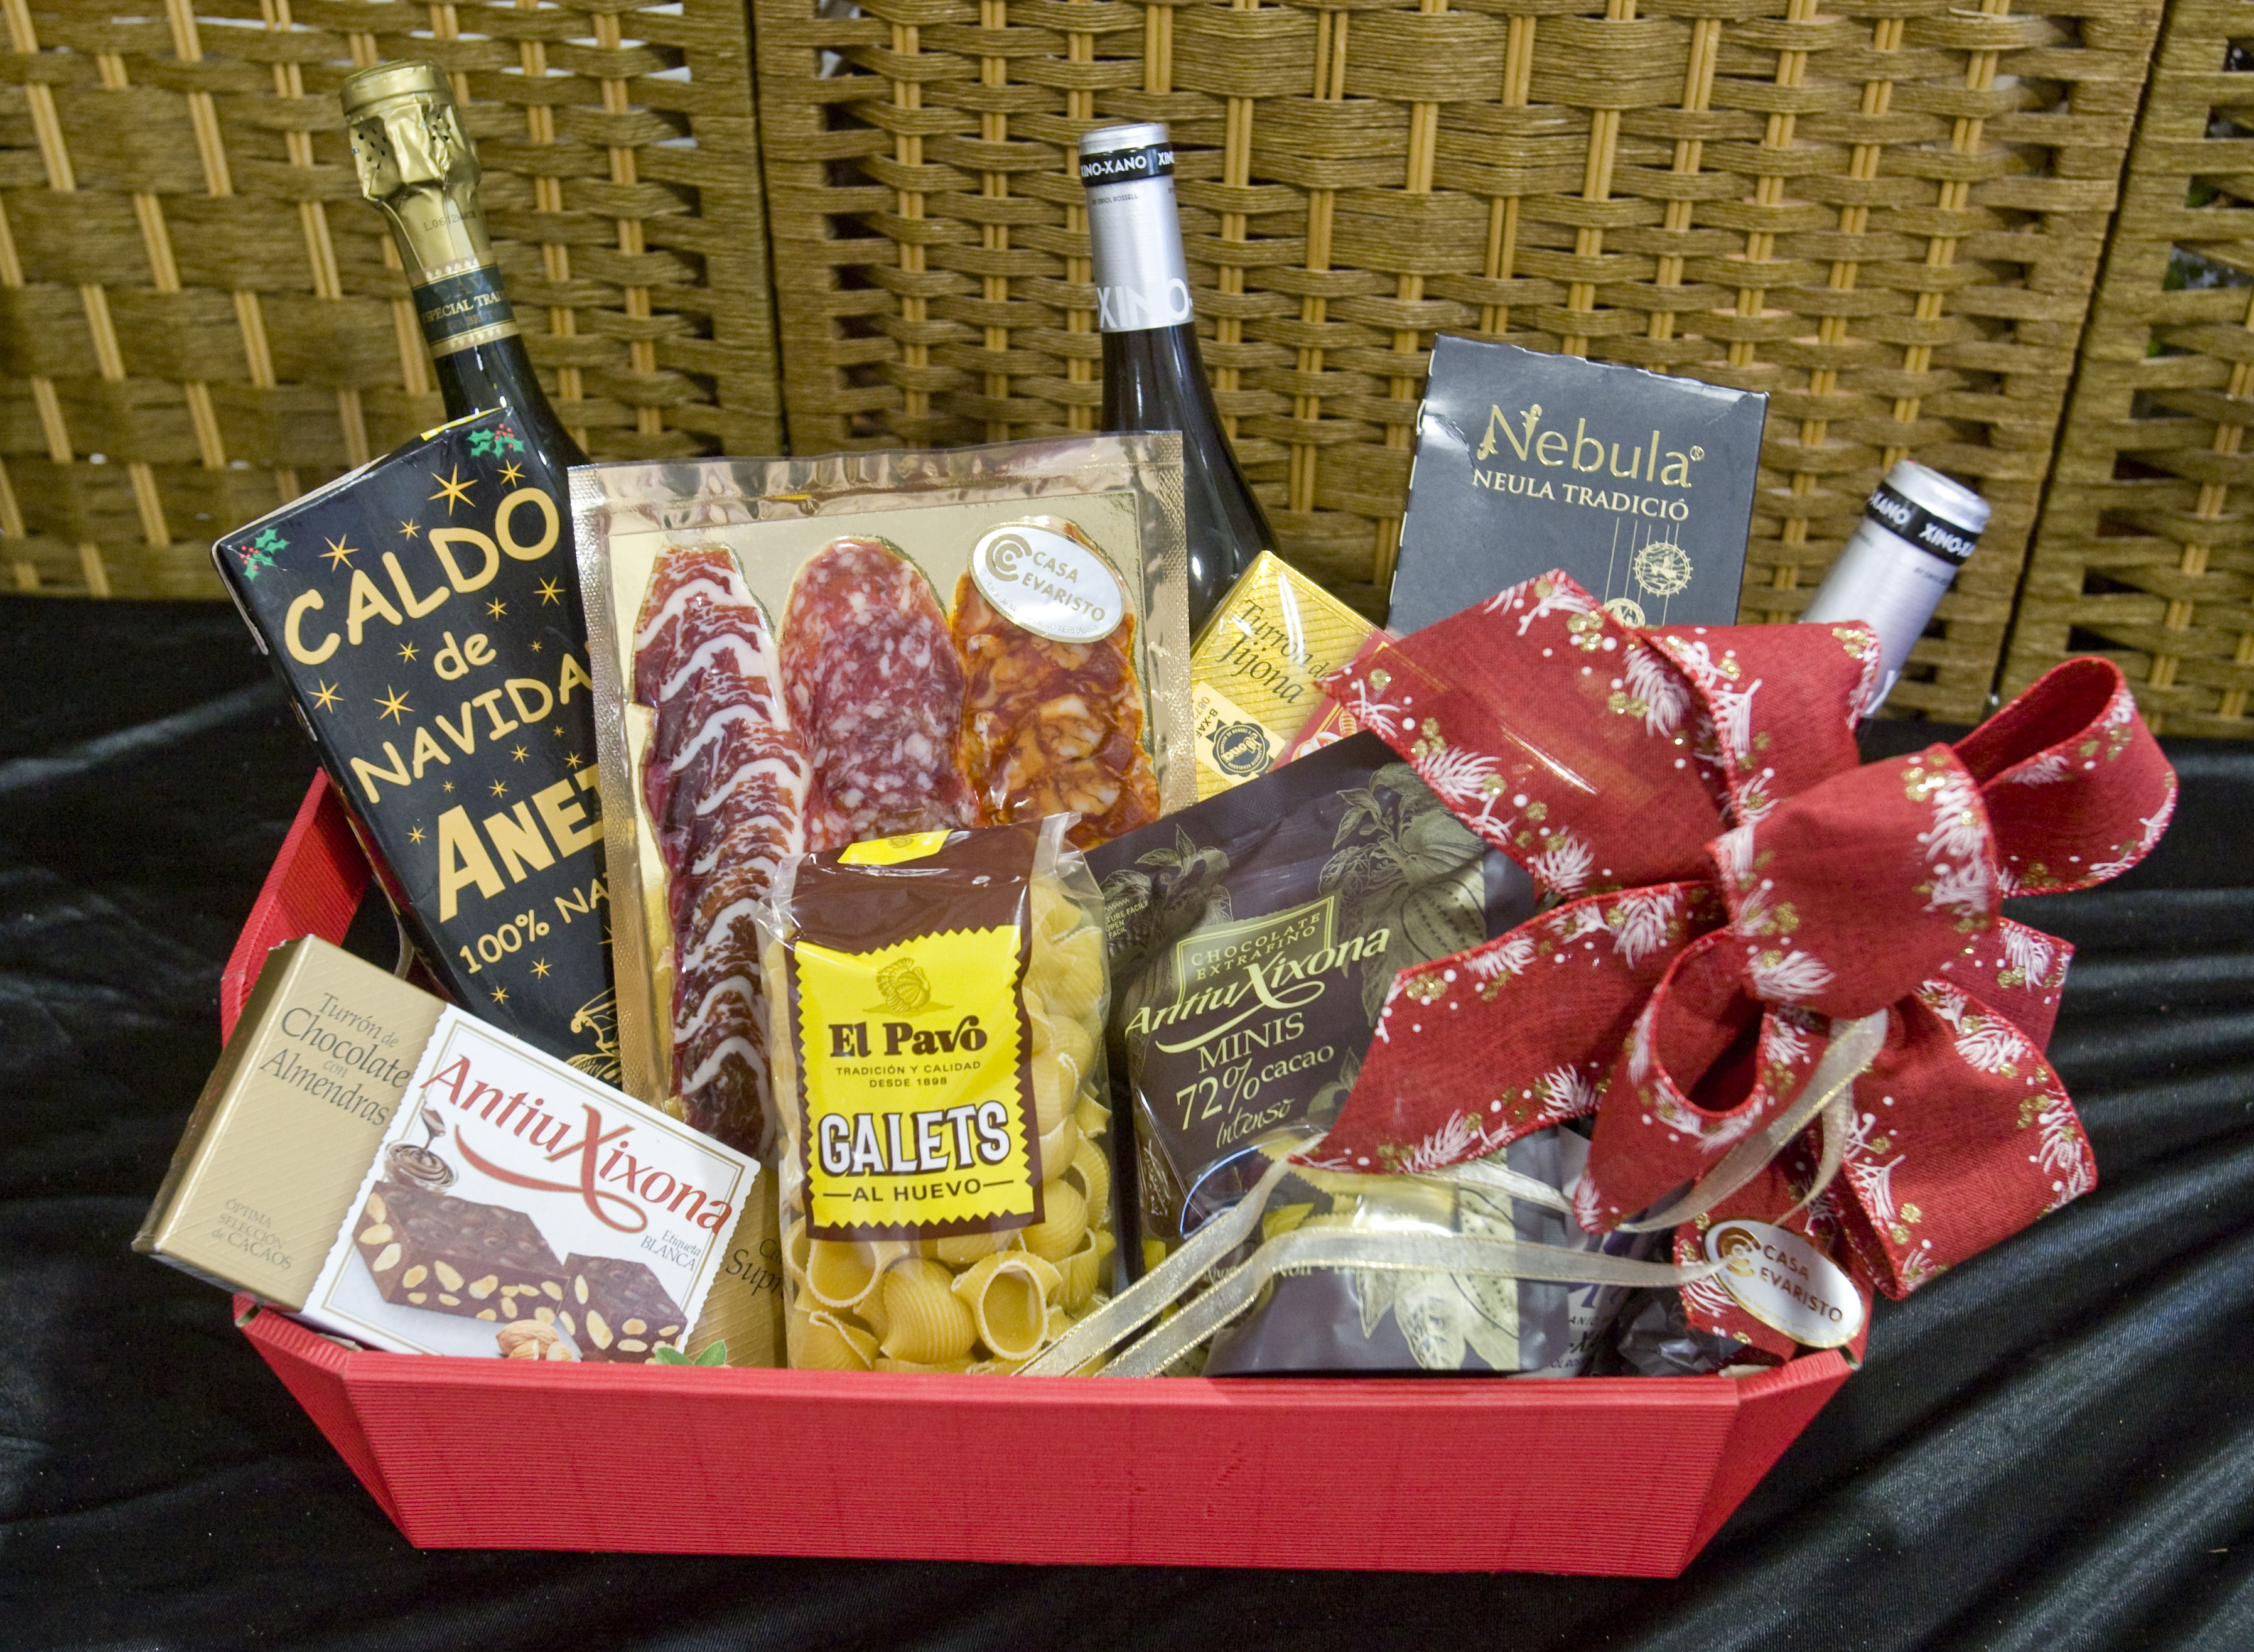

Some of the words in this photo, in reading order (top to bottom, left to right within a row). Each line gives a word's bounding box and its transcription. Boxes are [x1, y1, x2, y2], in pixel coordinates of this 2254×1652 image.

[1158, 151, 1174, 166] XIN
[1113, 193, 1138, 202] ROSSELL
[1472, 468, 1555, 501] NEULA
[1561, 483, 1690, 522] TRADICIÓ
[284, 487, 560, 665] CALDO
[1033, 551, 1078, 583] CASA
[1022, 572, 1105, 622] EVARISTO
[434, 631, 497, 680] de
[1216, 632, 1305, 704] Jijona
[350, 642, 593, 804] NAVIDA
[459, 909, 550, 974] 100%
[554, 873, 610, 924] NA
[1105, 919, 1125, 932] OPEN
[1126, 899, 1149, 915] FACILE
[1108, 926, 1126, 940] FACIL
[1190, 911, 1321, 968] CHOCOLATE
[1197, 926, 1316, 981] EXTRAFINO
[1124, 927, 1391, 1055] AntiuXixona
[318, 992, 382, 1037] Turrón
[380, 1030, 399, 1048] de
[828, 1020, 872, 1057] El
[1199, 1012, 1305, 1074] MINIS
[281, 1007, 412, 1089] Chocolate
[322, 1057, 348, 1078] con
[836, 1065, 905, 1076] TRADICIÓN
[911, 1066, 919, 1074] Y
[924, 1061, 981, 1074] CALIDAD
[259, 1048, 391, 1127] Almendras
[869, 1078, 910, 1088] DESDE
[917, 1077, 947, 1087] 1898
[1175, 1057, 1259, 1131] 72%
[1261, 1045, 1334, 1082] cacao
[419, 1054, 734, 1235] AntiuXixona
[818, 1099, 1012, 1177] GALETS
[1216, 1098, 1296, 1149] Intenso
[225, 1197, 273, 1229] ÓPTIMA
[852, 1185, 884, 1202] AL
[895, 1178, 982, 1201] HUEVO
[218, 1212, 286, 1250] SELECCIÓN
[227, 1231, 294, 1270] CACAOS
[640, 1235, 696, 1271] BLANCA
[661, 1229, 703, 1258] Etiqueta
[725, 1249, 784, 1300] Supr
[1763, 1244, 1810, 1282] CASA
[1760, 1266, 1843, 1323] EVARISTO
